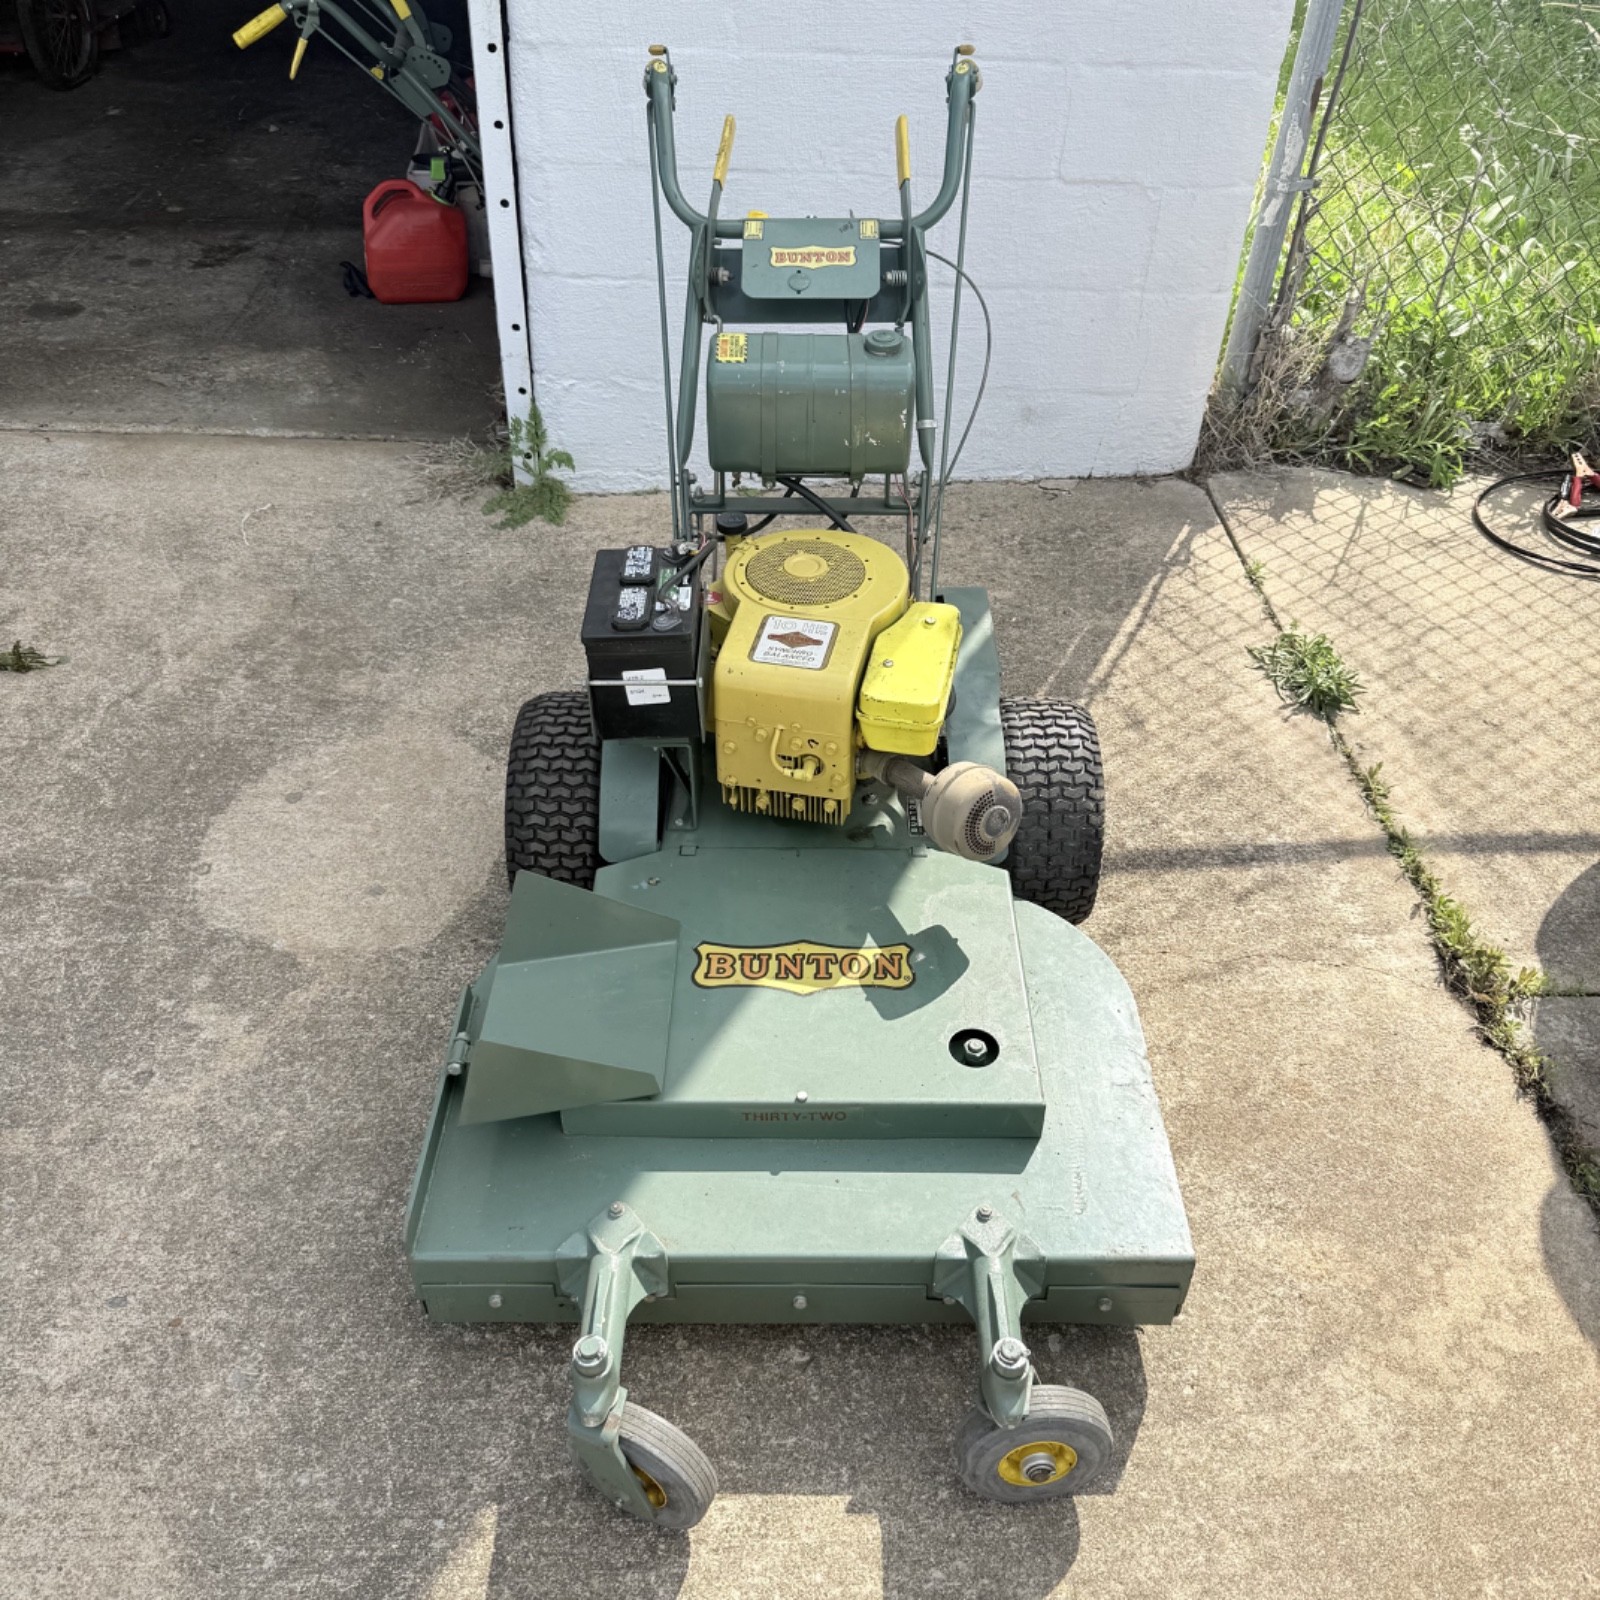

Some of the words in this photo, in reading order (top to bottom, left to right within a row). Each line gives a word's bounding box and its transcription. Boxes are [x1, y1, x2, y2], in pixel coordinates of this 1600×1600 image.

[774, 251, 851, 264] BUNTON
[704, 953, 903, 980] BUNTON
[742, 1111, 848, 1122] THIRTY-TWO
